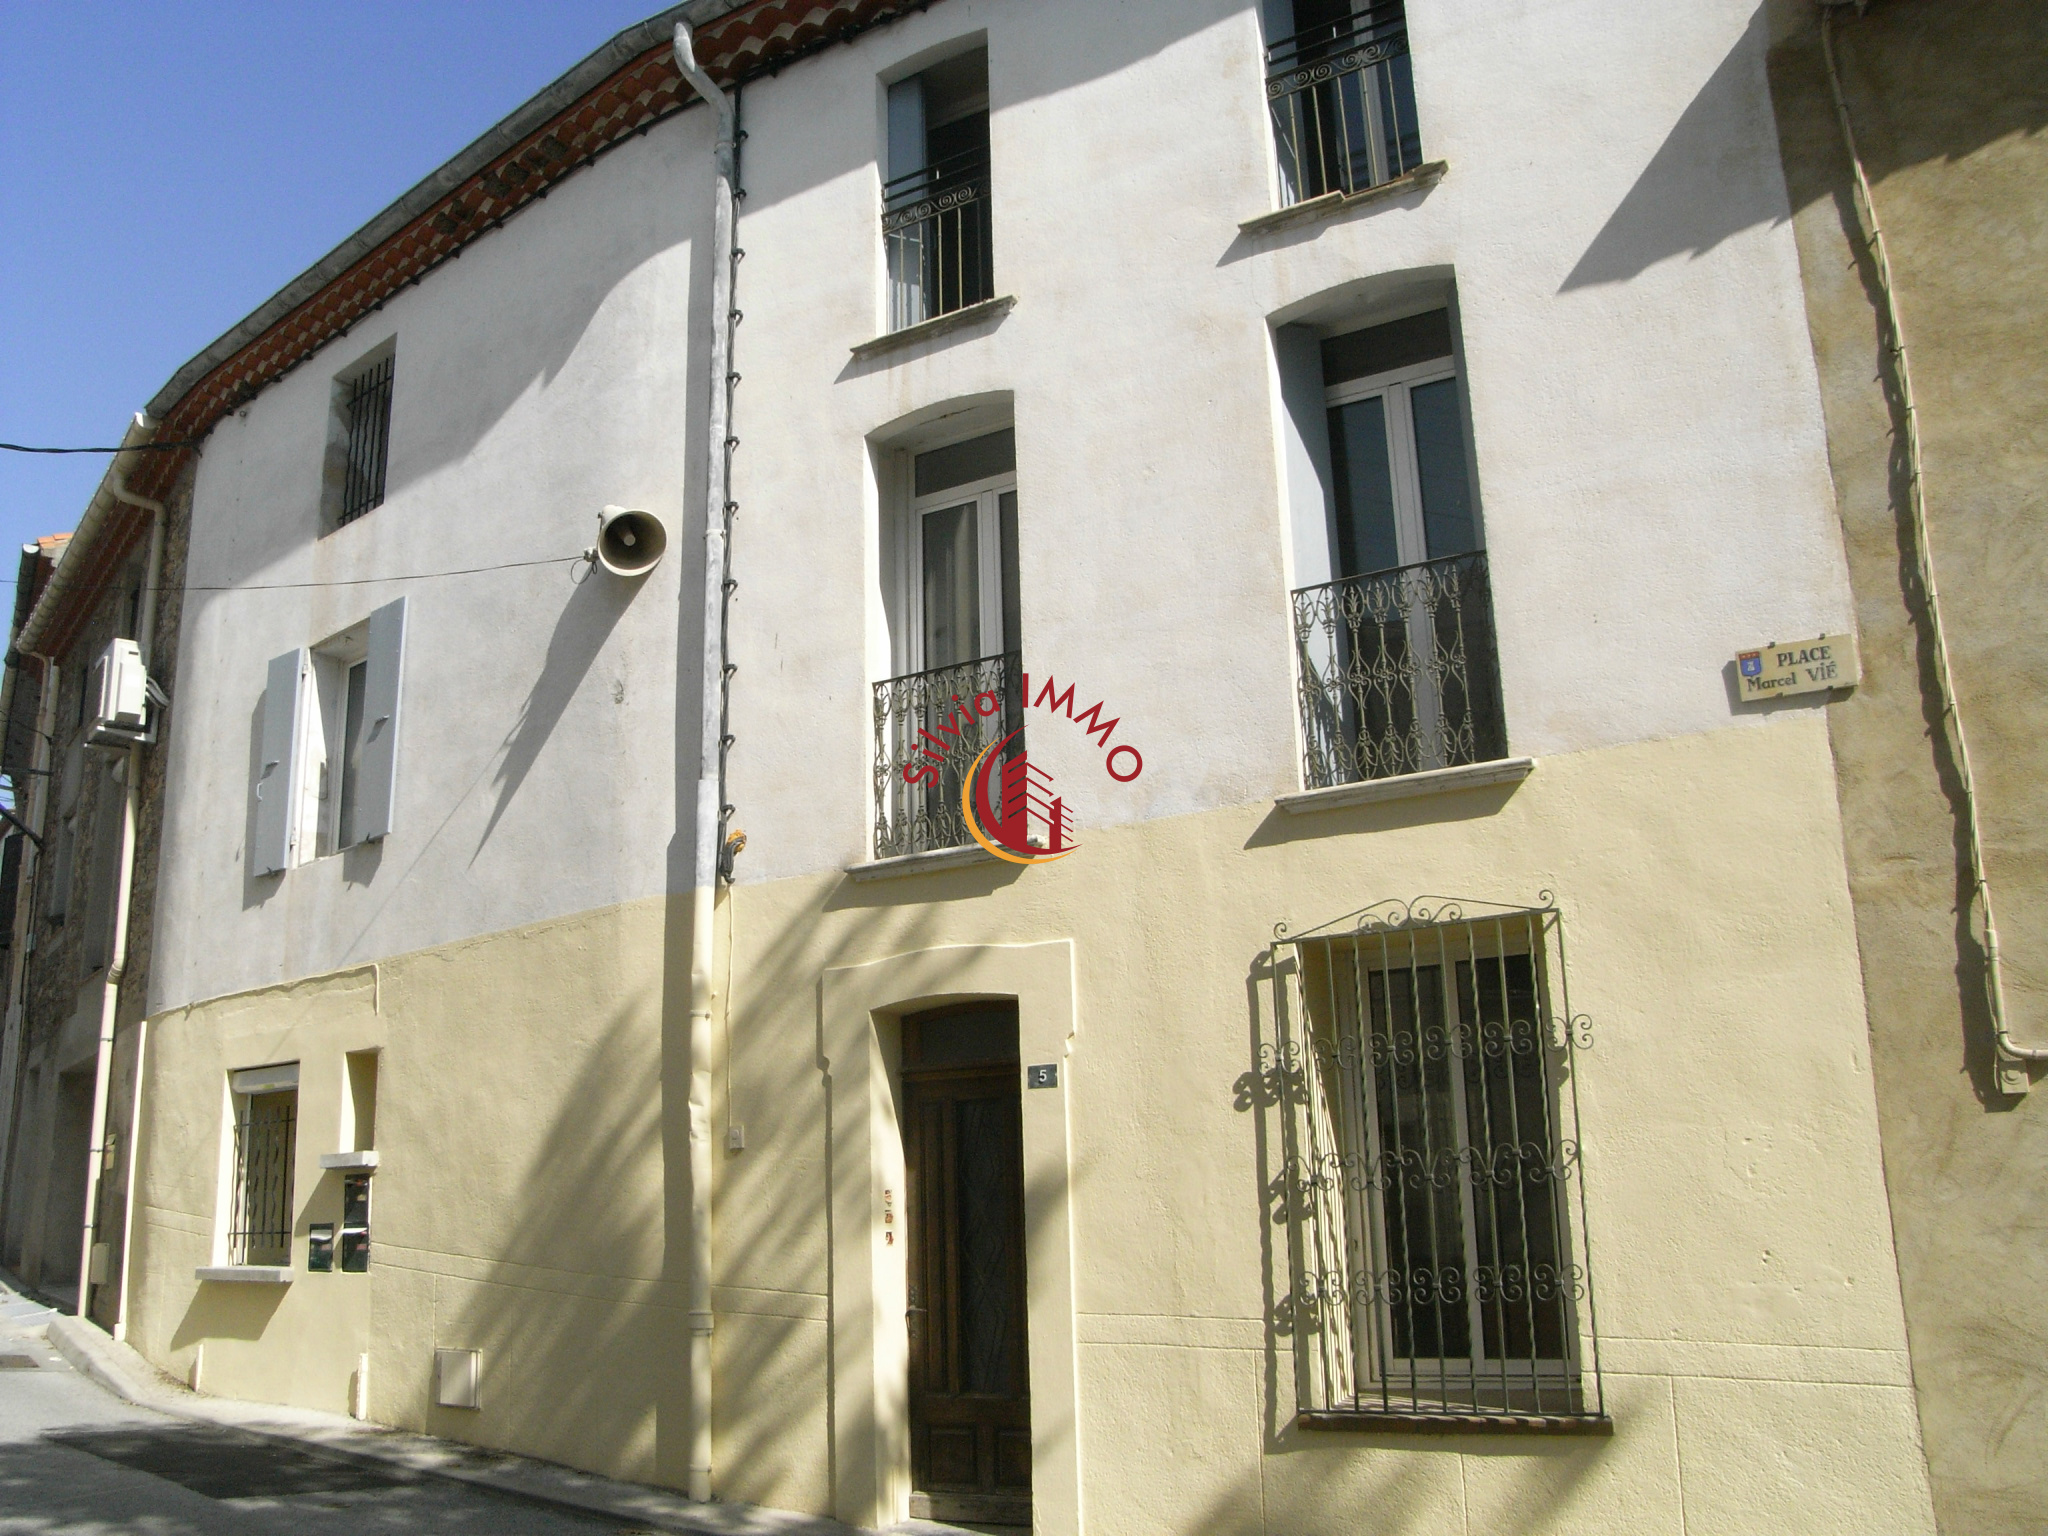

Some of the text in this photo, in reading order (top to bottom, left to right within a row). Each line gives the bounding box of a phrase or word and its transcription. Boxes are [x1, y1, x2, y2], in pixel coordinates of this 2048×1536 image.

[1777, 645, 1831, 667] PLACE
[1747, 672, 1797, 692] Marcel
[1039, 1069, 1047, 1082] 5
